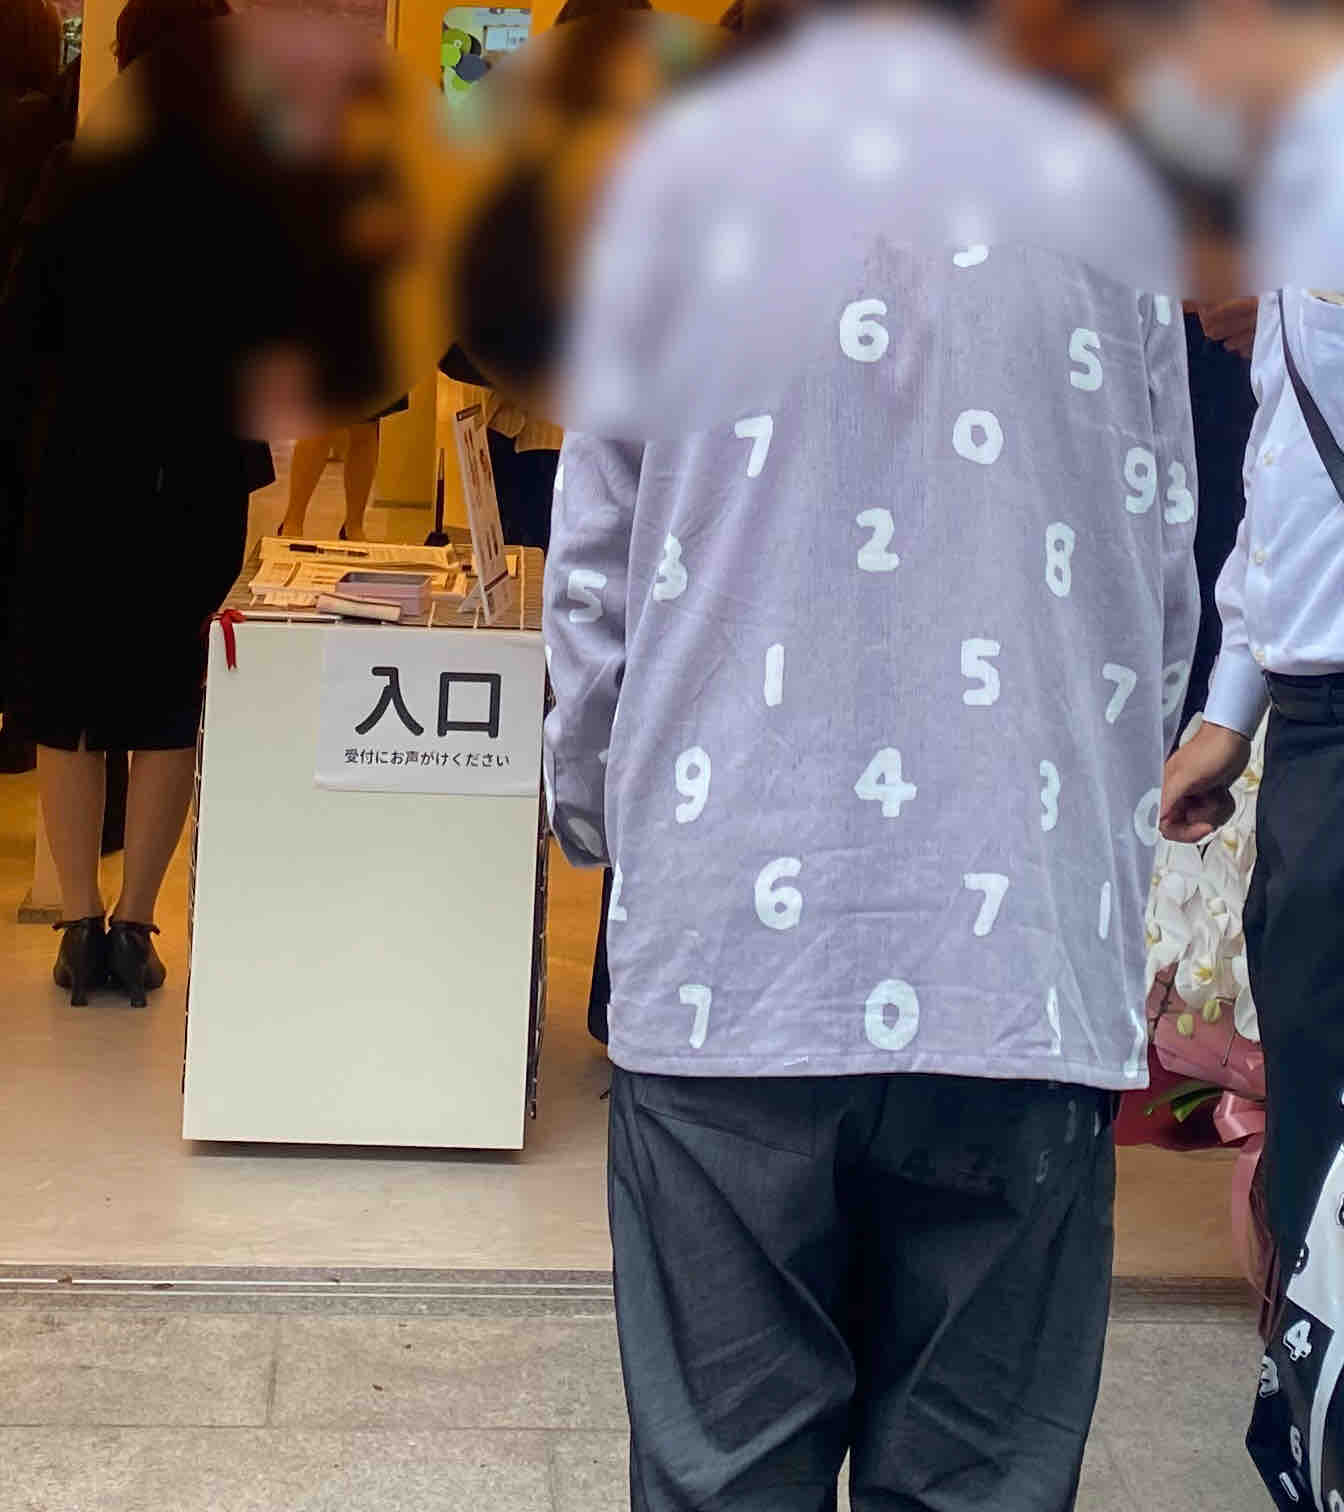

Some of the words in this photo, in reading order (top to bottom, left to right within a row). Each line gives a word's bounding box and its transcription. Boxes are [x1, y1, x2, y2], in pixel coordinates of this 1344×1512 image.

[839, 298, 890, 362] 6
[1068, 327, 1104, 391] 5
[734, 414, 775, 478] 7
[951, 408, 1004, 466] 0
[1124, 446, 1158, 515] 9
[855, 507, 901, 573] 2
[1045, 521, 1076, 598] 8
[354, 666, 502, 739] 入口
[763, 642, 785, 707] 1
[961, 638, 1002, 706] 5
[1102, 663, 1138, 725] 7
[343, 748, 511, 768] 受付にお声がけください
[674, 745, 712, 824] 9
[853, 747, 918, 818] 4
[753, 856, 804, 931] 6
[963, 872, 1010, 937] 7
[678, 984, 713, 1050] 7
[864, 978, 921, 1051] 0
[1282, 1319, 1313, 1362] 4
